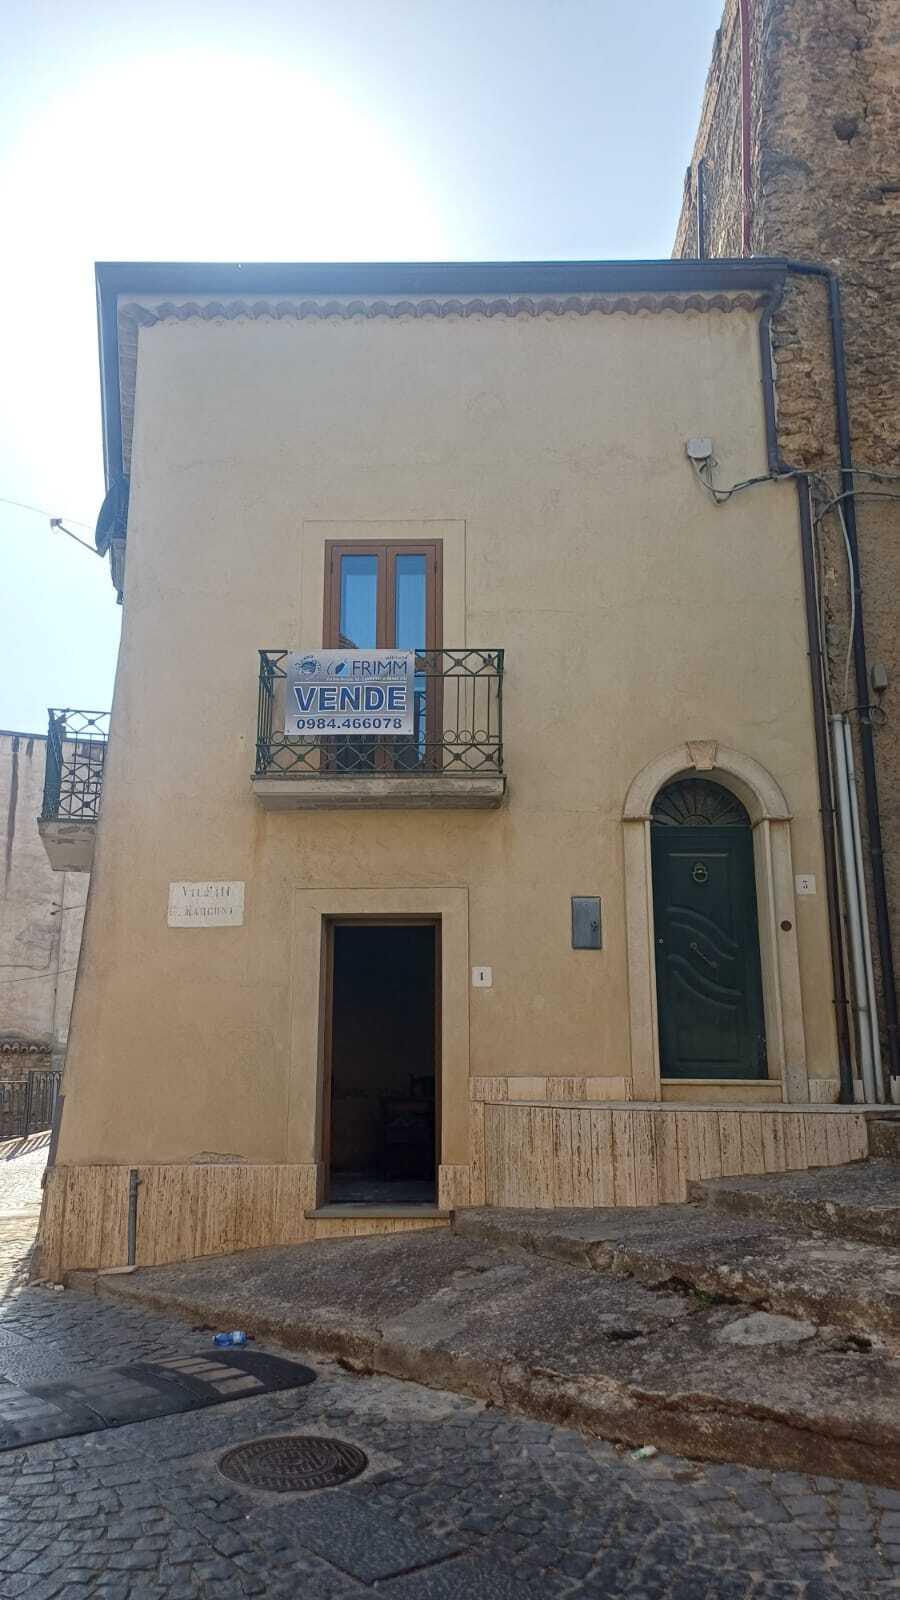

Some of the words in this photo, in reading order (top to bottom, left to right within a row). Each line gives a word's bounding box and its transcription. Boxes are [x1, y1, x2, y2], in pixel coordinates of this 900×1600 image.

[352, 661, 407, 676] FRIMM
[294, 686, 407, 712] VENDE
[297, 718, 402, 729] 0984.466078
